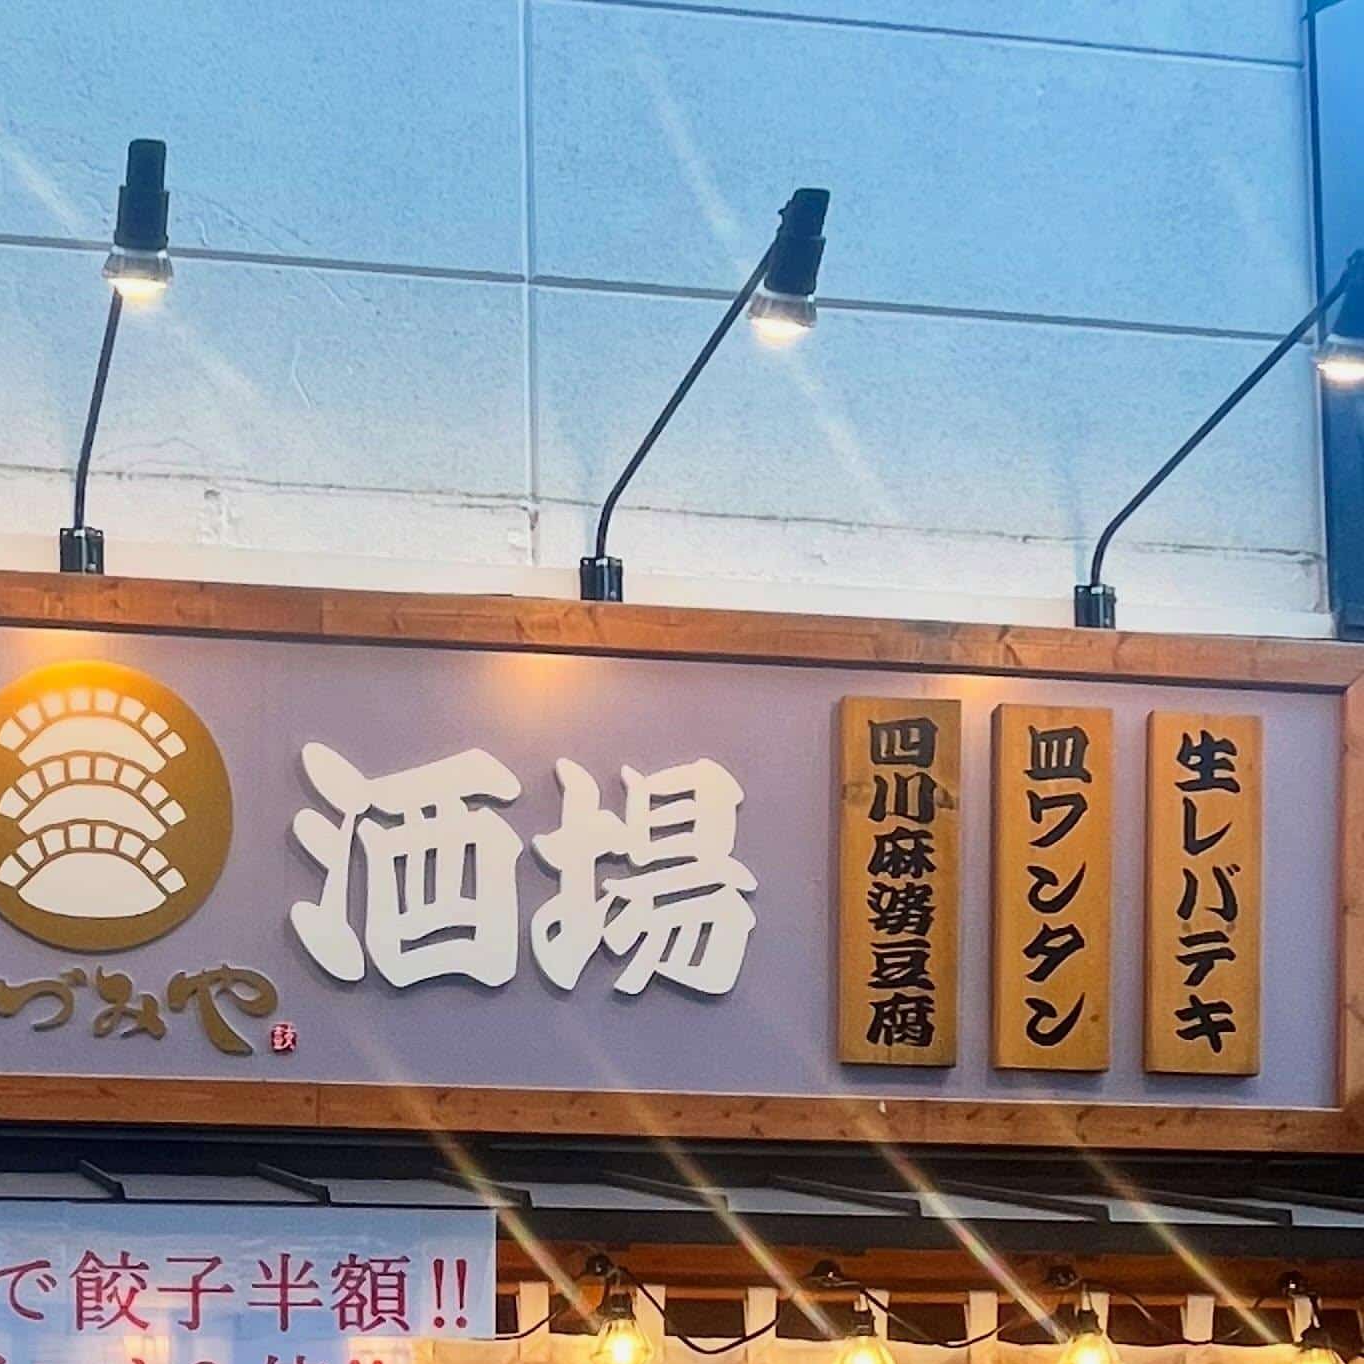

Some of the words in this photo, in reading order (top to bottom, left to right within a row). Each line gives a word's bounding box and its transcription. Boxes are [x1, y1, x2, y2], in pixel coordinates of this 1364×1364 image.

[290, 742, 758, 995] 酒場
[866, 717, 938, 1047] 四川麻婆豆腐
[1023, 726, 1092, 1046] 皿ワンタン
[1175, 730, 1241, 1054] 生レバテキ
